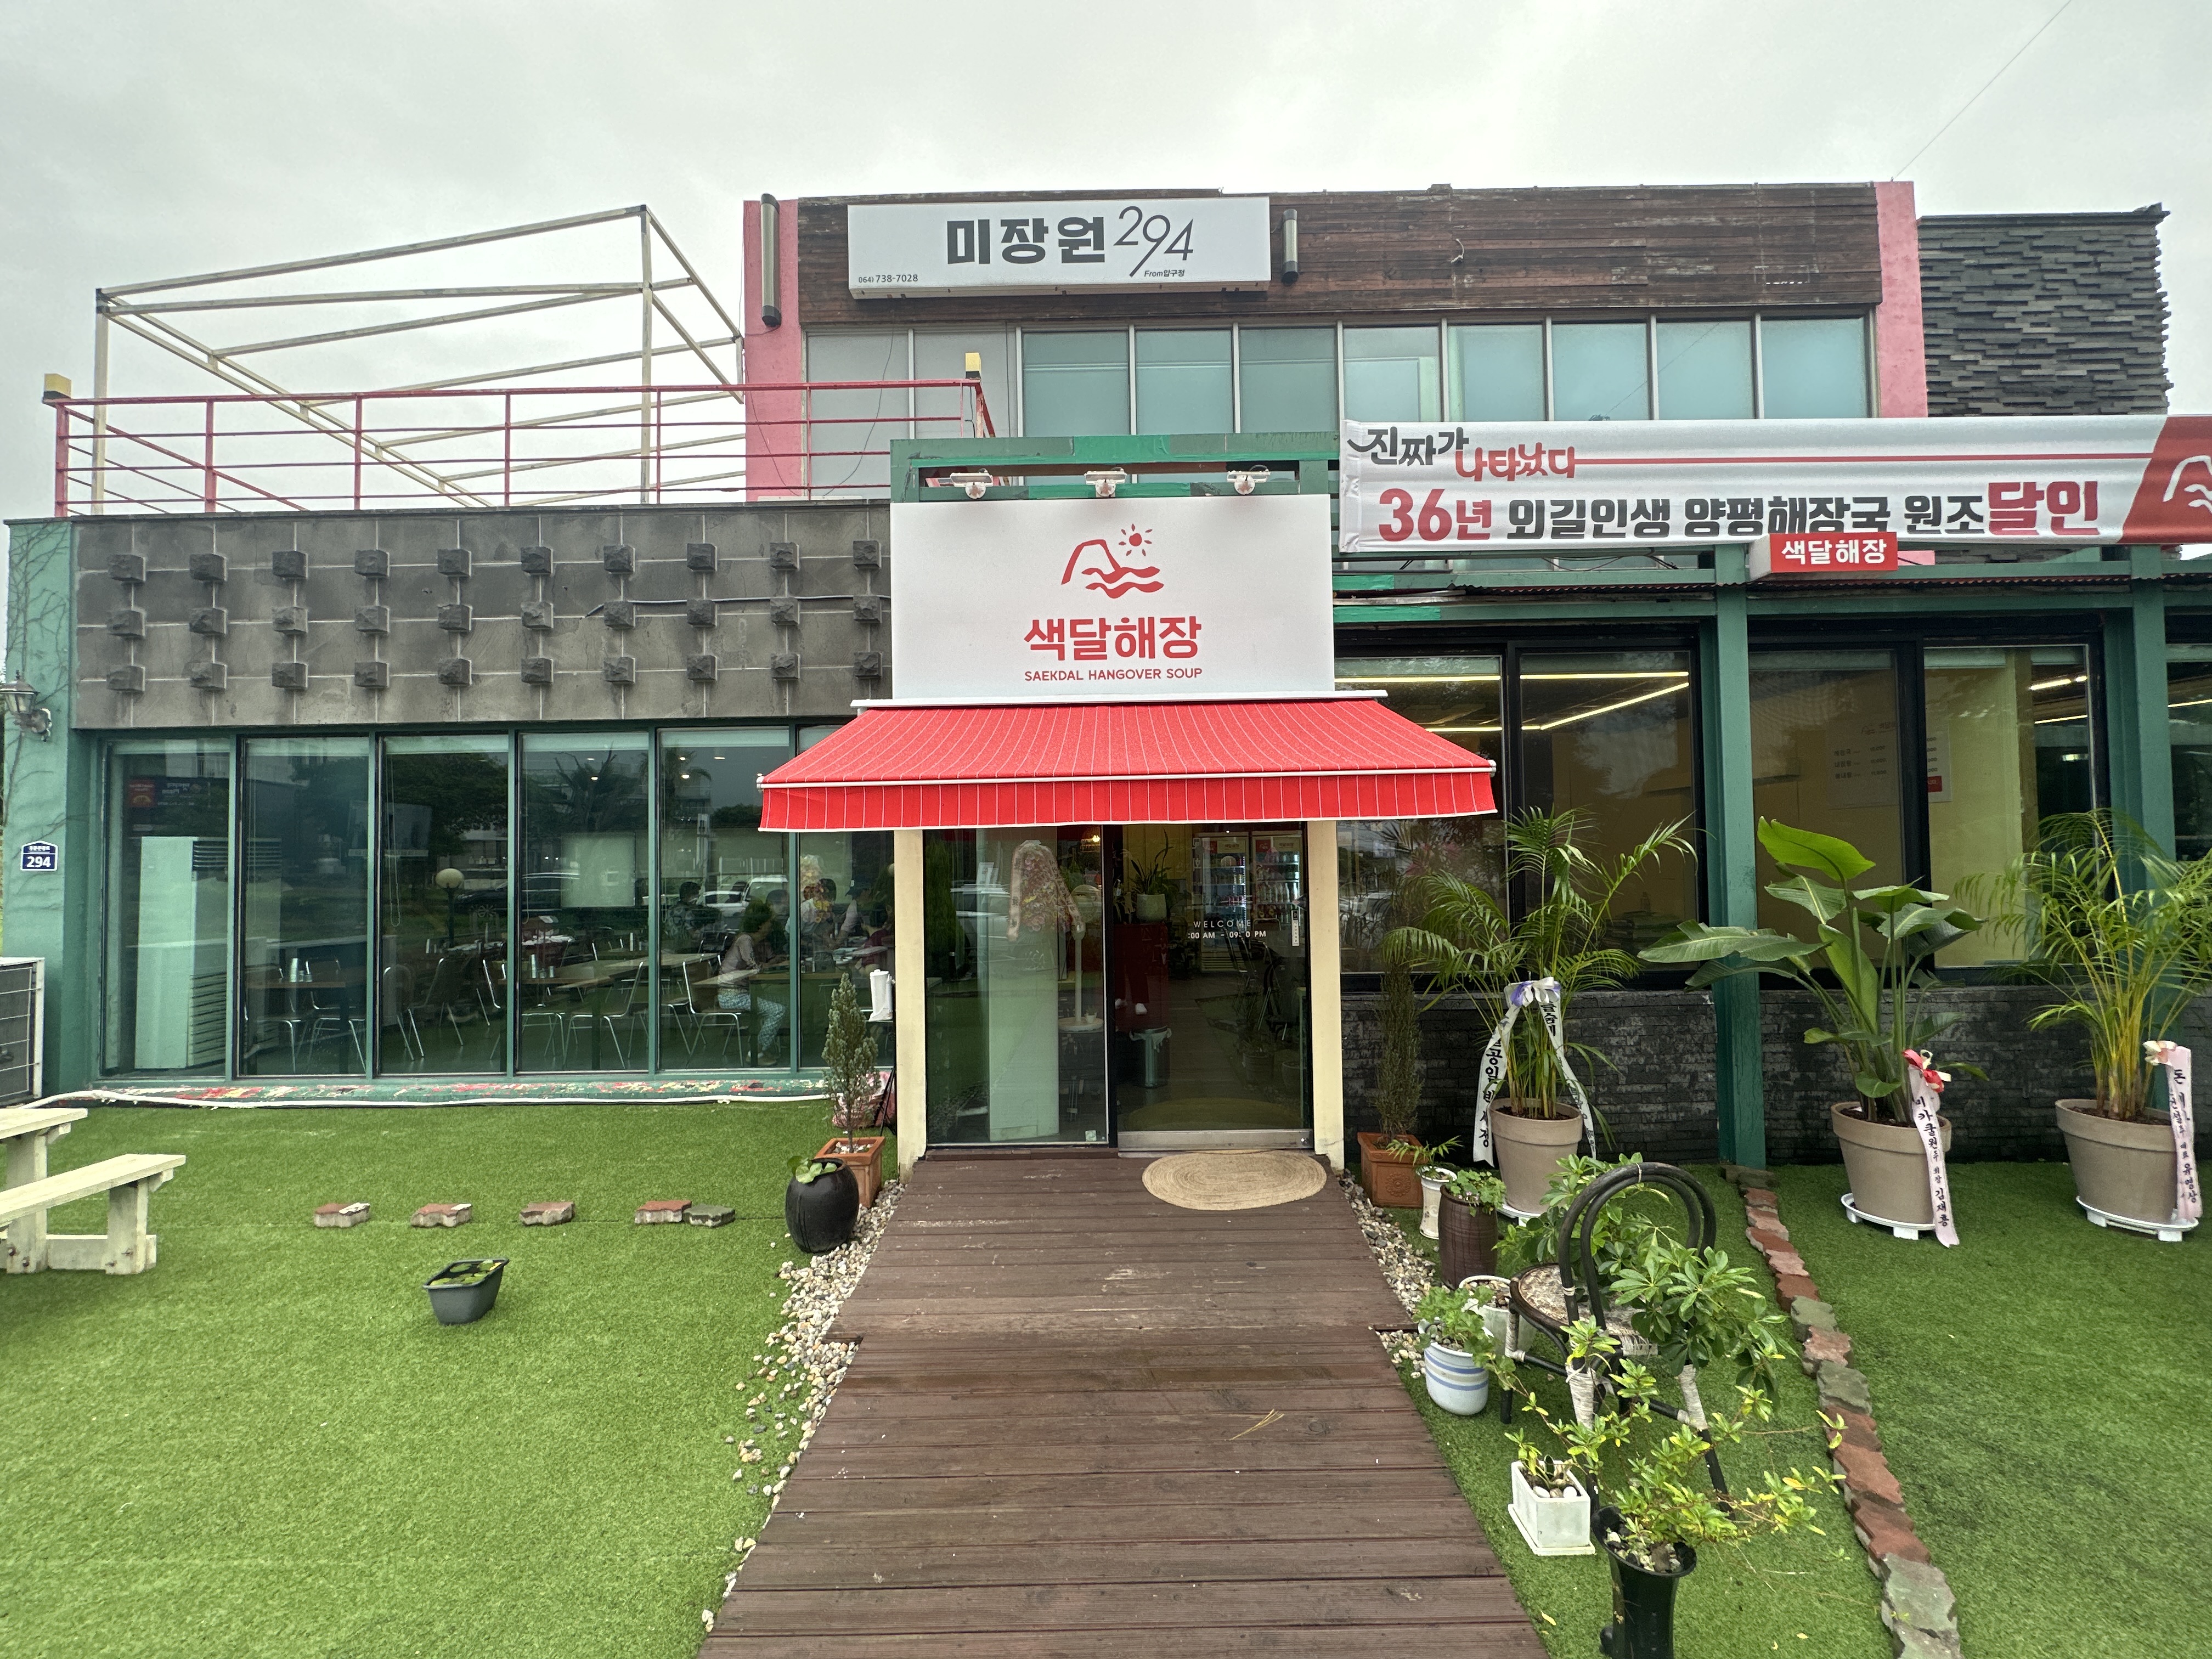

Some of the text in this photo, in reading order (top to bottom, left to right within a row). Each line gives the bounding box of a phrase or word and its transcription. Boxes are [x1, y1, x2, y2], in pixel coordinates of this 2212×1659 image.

[947, 206, 1194, 277] 미장원 294
[875, 274, 918, 283] 738-7028
[1144, 269, 1185, 277] From압구정
[1347, 426, 1576, 482] 진짜가 나타났다
[1378, 488, 1491, 541] 36년
[1507, 498, 1670, 540] 외길인생
[1684, 494, 1891, 537] 양평해장국
[1781, 539, 1887, 566] 색달해장
[1024, 616, 1202, 661] 색달해장
[1024, 668, 1203, 681] SAEKDAL HANGOVER SOUP
[26, 856, 52, 868] 294
[1193, 919, 1251, 928] WELCOME
